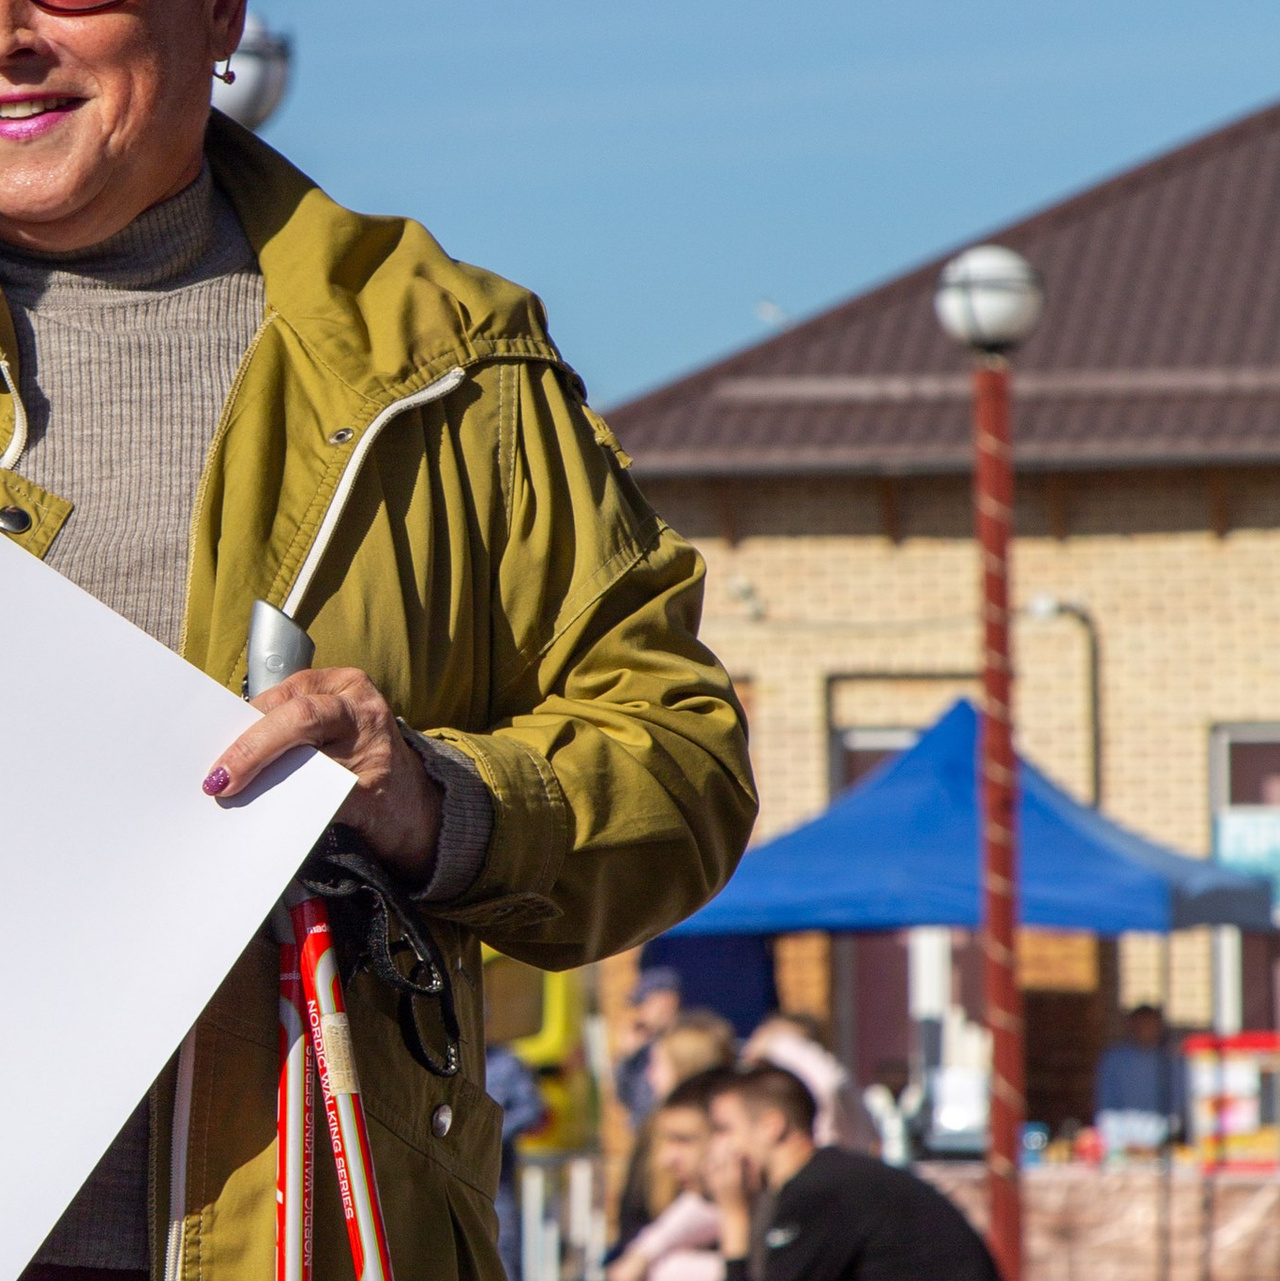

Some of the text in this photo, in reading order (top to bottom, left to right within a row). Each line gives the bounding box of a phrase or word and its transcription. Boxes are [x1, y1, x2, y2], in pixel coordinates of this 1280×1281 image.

[308, 1000, 354, 1220] NORDIC WALKING SERIES
